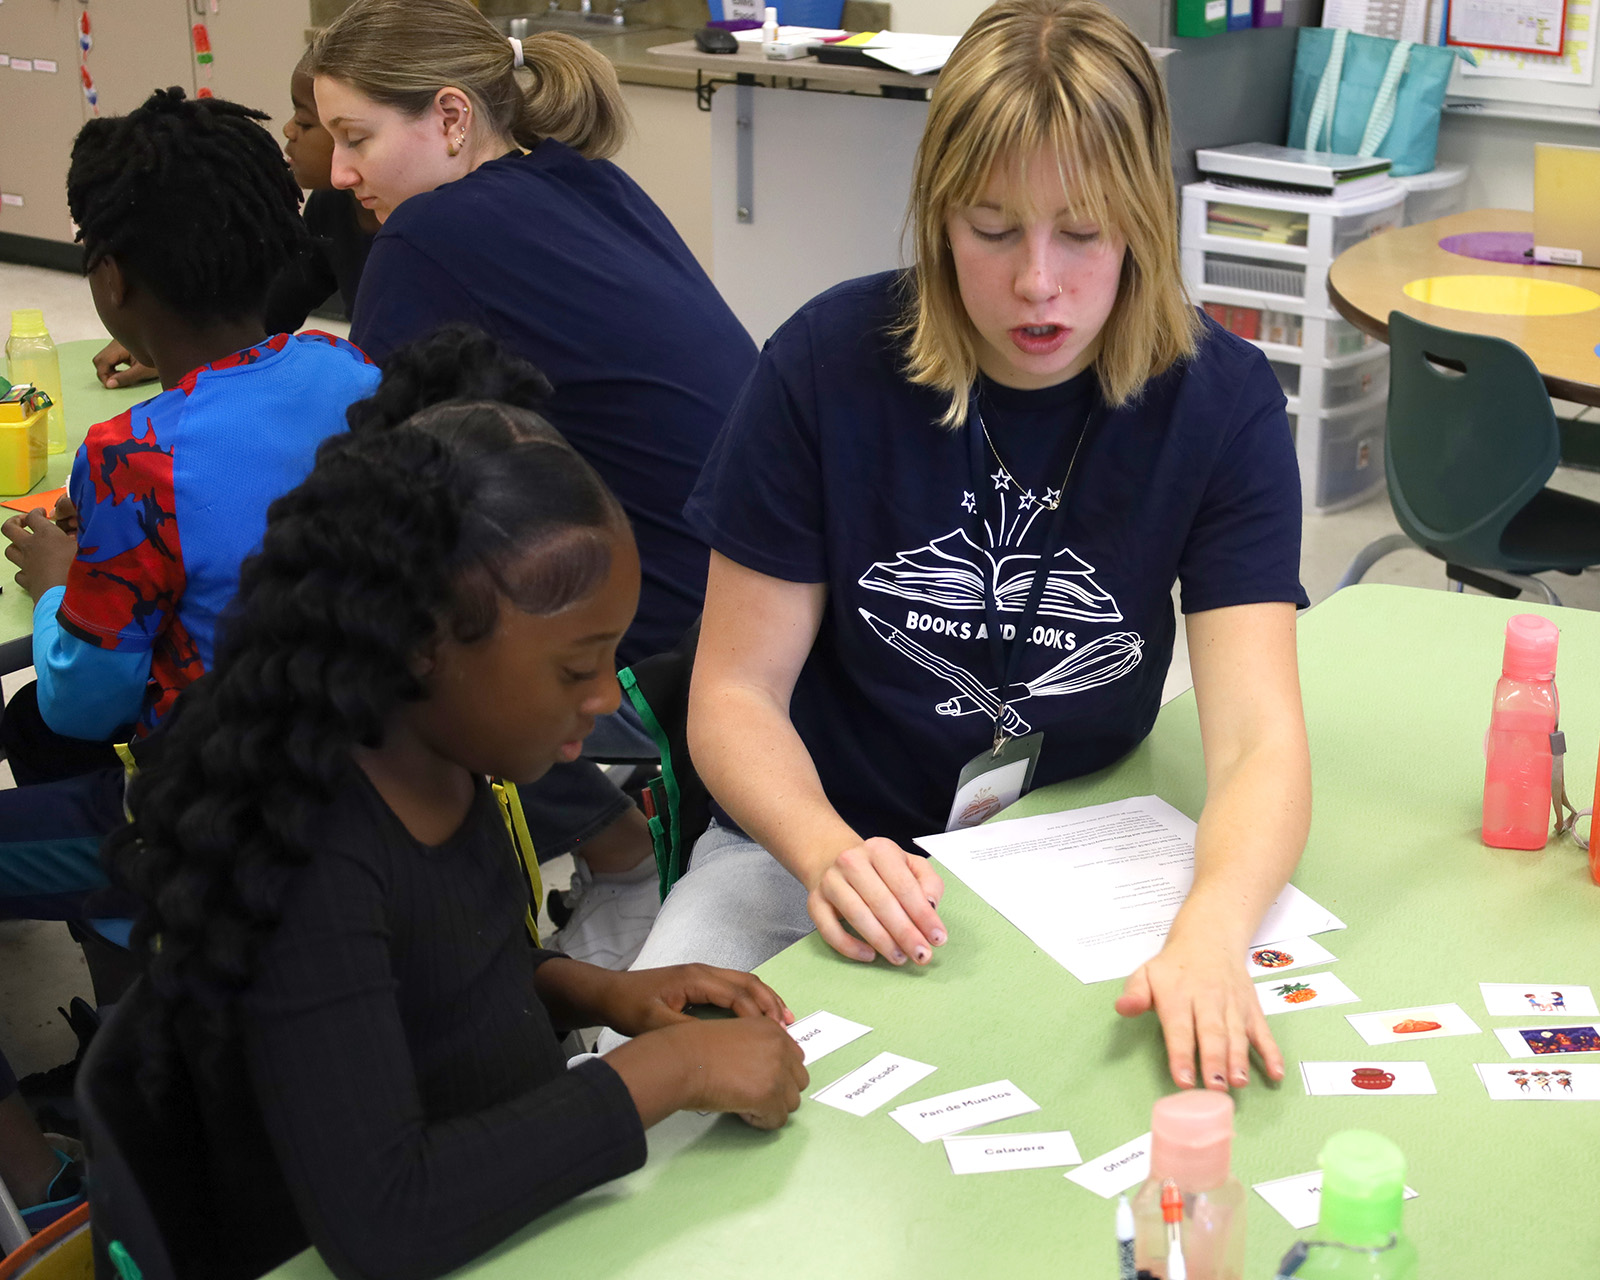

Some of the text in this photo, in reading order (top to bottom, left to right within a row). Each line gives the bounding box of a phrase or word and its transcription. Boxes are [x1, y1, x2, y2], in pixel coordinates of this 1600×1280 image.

[906, 610, 972, 640] BOOKS
[845, 1064, 899, 1100] Papel Picado
[919, 1109, 944, 1118] Pan
[961, 1092, 1011, 1107] Muertos
[984, 1146, 1045, 1156] Calavera
[1103, 1151, 1145, 1172] Ofrenda
